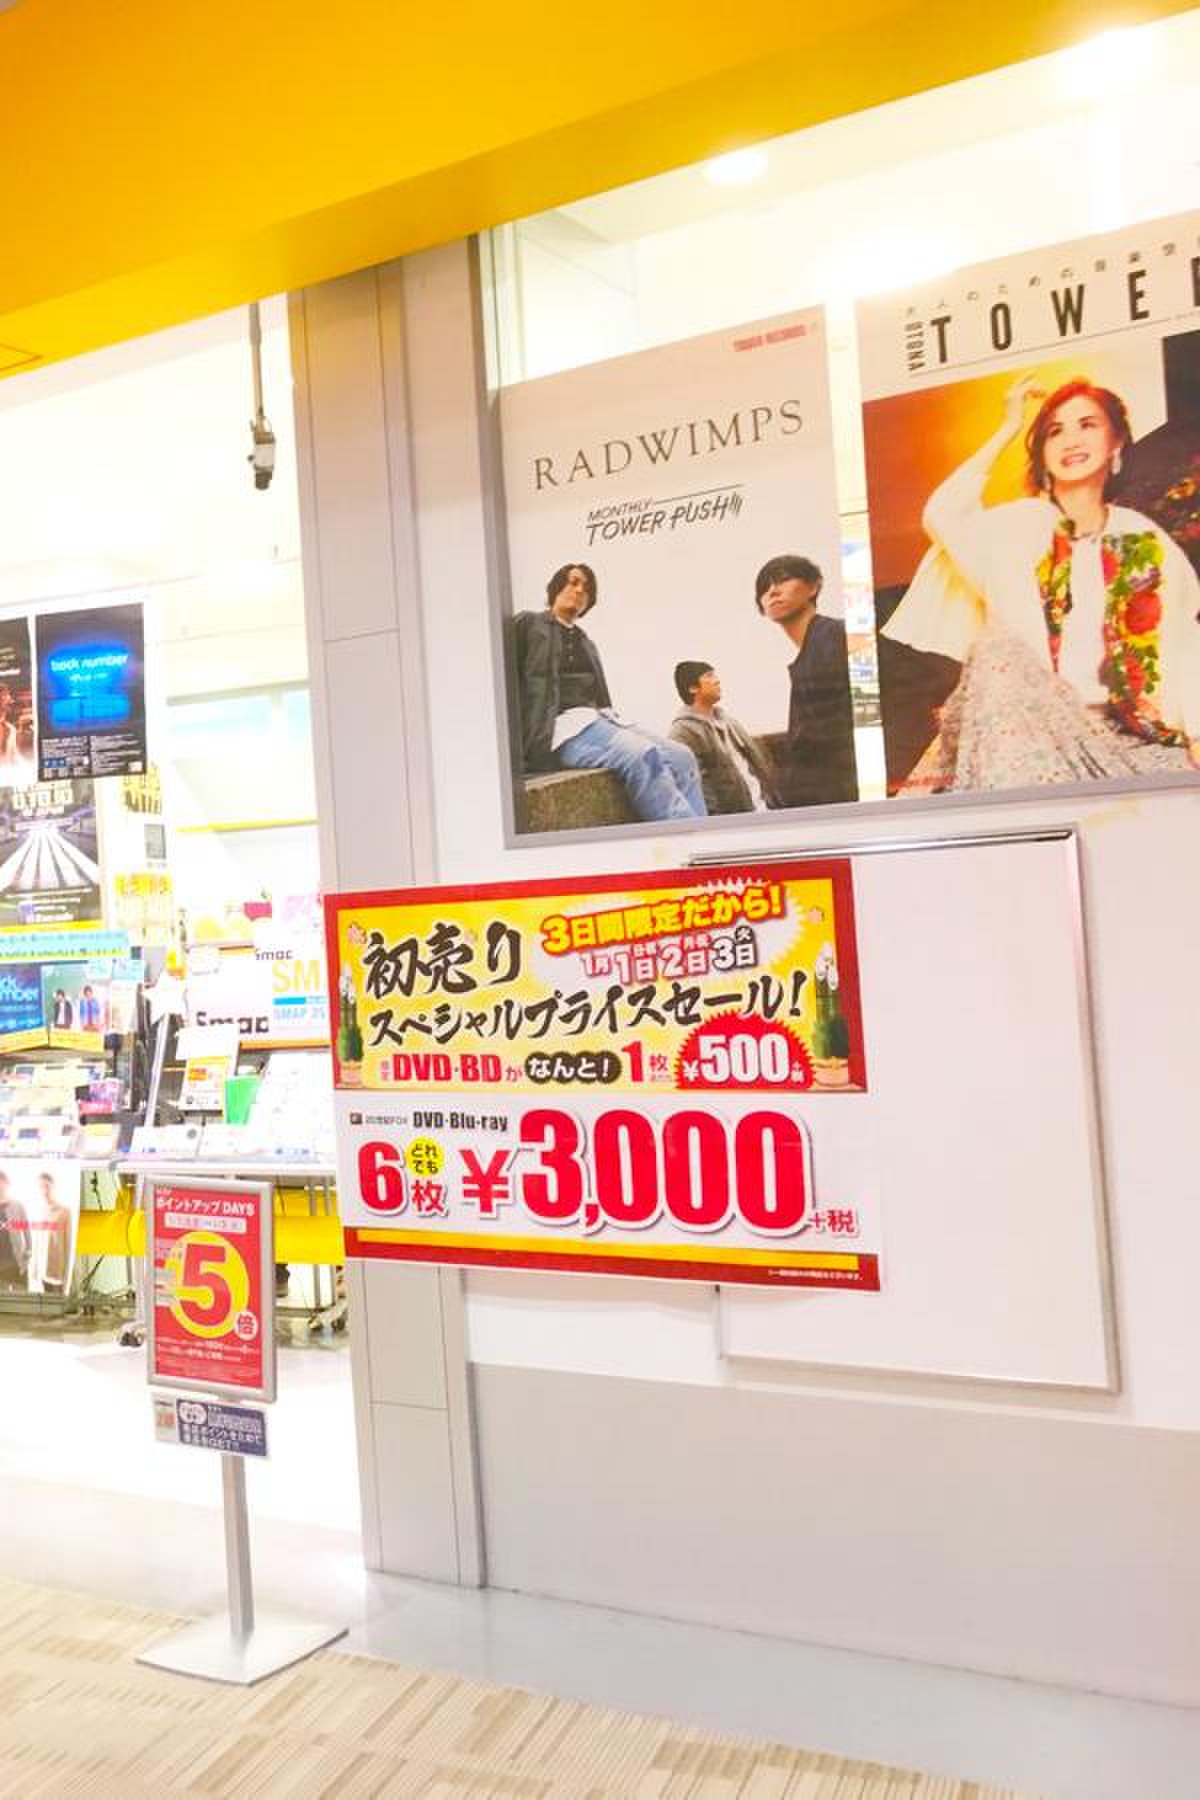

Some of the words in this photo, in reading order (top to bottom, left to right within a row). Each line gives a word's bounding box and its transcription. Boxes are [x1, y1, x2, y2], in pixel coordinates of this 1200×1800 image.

[931, 255, 1200, 364] TOWE
[533, 399, 803, 490] RADWIMPS
[586, 510, 664, 546] TOWER
[587, 501, 651, 522] MONTHLY
[362, 920, 522, 1001] 初売り
[369, 970, 808, 1047] スペシャルプライスセール!
[529, 1056, 612, 1079] なんと!
[622, 1040, 645, 1083] 1
[682, 1033, 791, 1084] ¥500
[357, 1140, 406, 1212] 6
[411, 1180, 446, 1214] 枚
[458, 1107, 808, 1231] ¥3,000
[808, 1208, 856, 1233] +税
[411, 1143, 439, 1158] どれ
[411, 1160, 440, 1175] でも
[223, 1202, 255, 1217] DAYS
